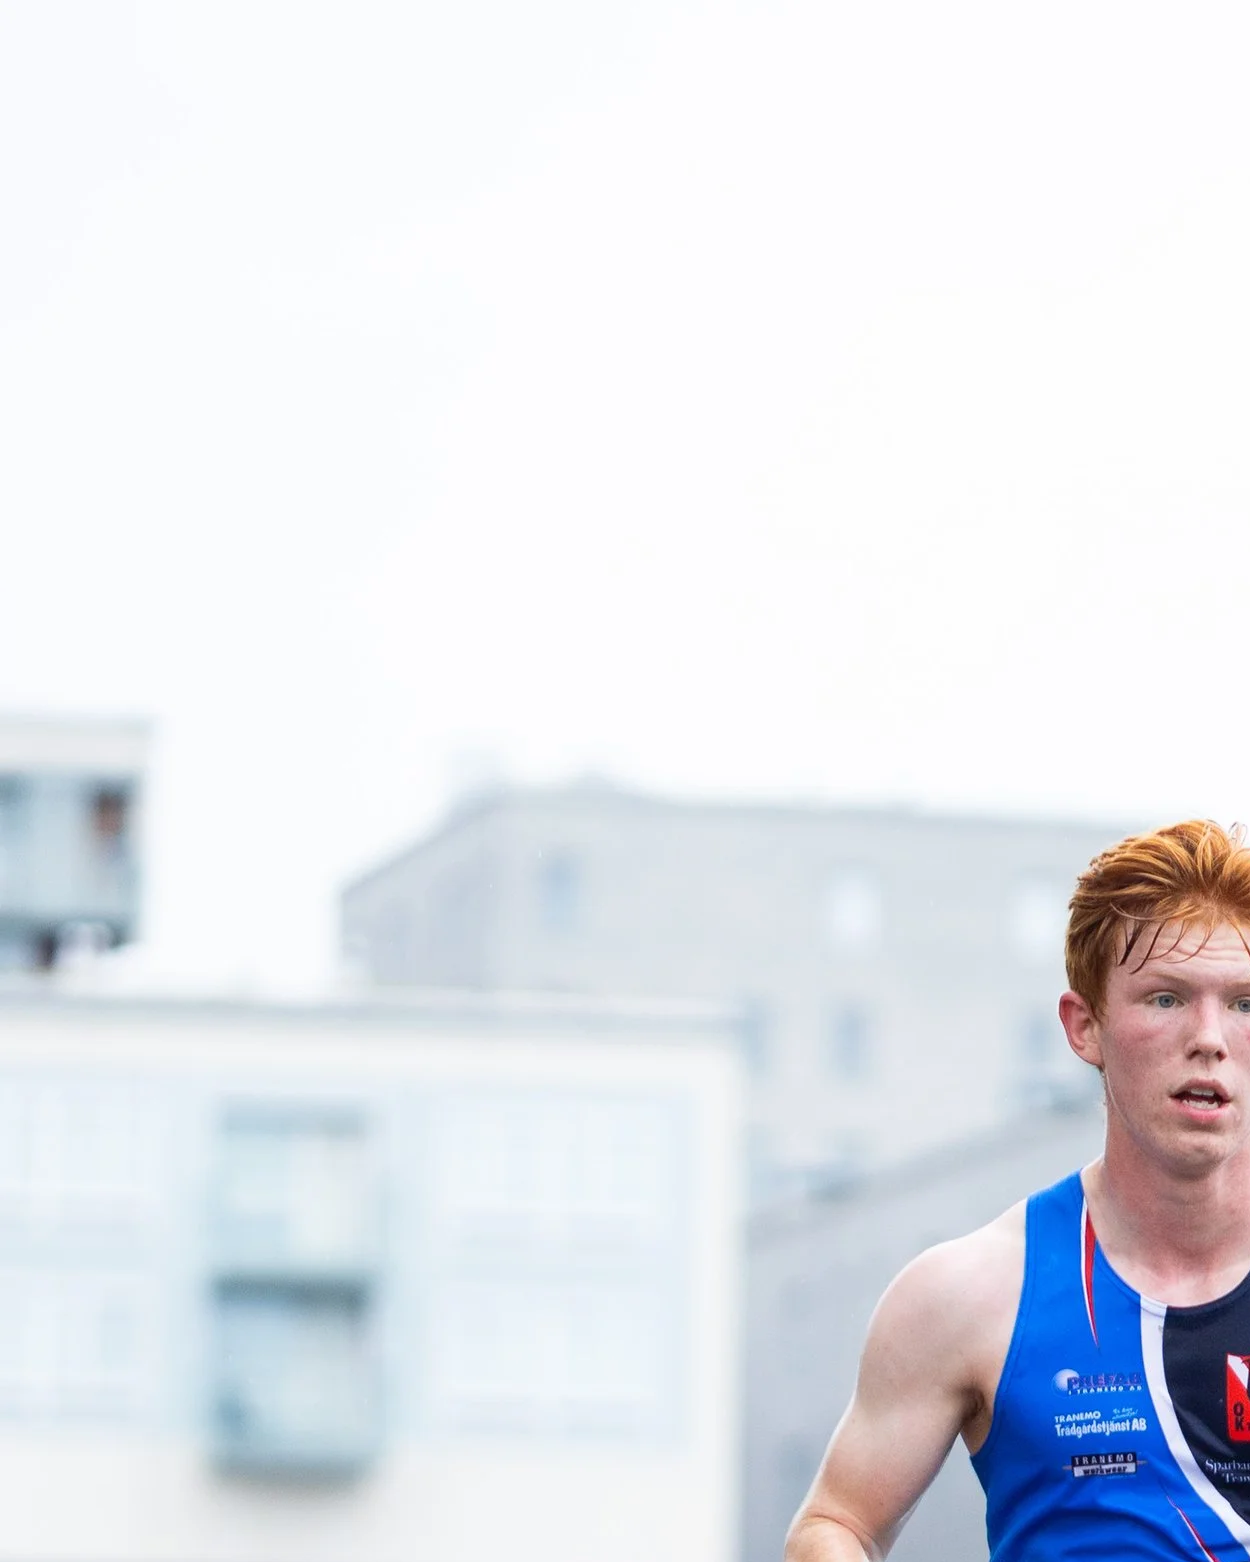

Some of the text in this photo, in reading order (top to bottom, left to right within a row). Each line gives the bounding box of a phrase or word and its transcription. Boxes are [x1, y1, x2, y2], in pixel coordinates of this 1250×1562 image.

[1054, 1410, 1101, 1423] TRANEMO
[1131, 1417, 1147, 1431] AB
[1074, 1453, 1134, 1465] TRANEMO
[1082, 1464, 1128, 1475] workwear
